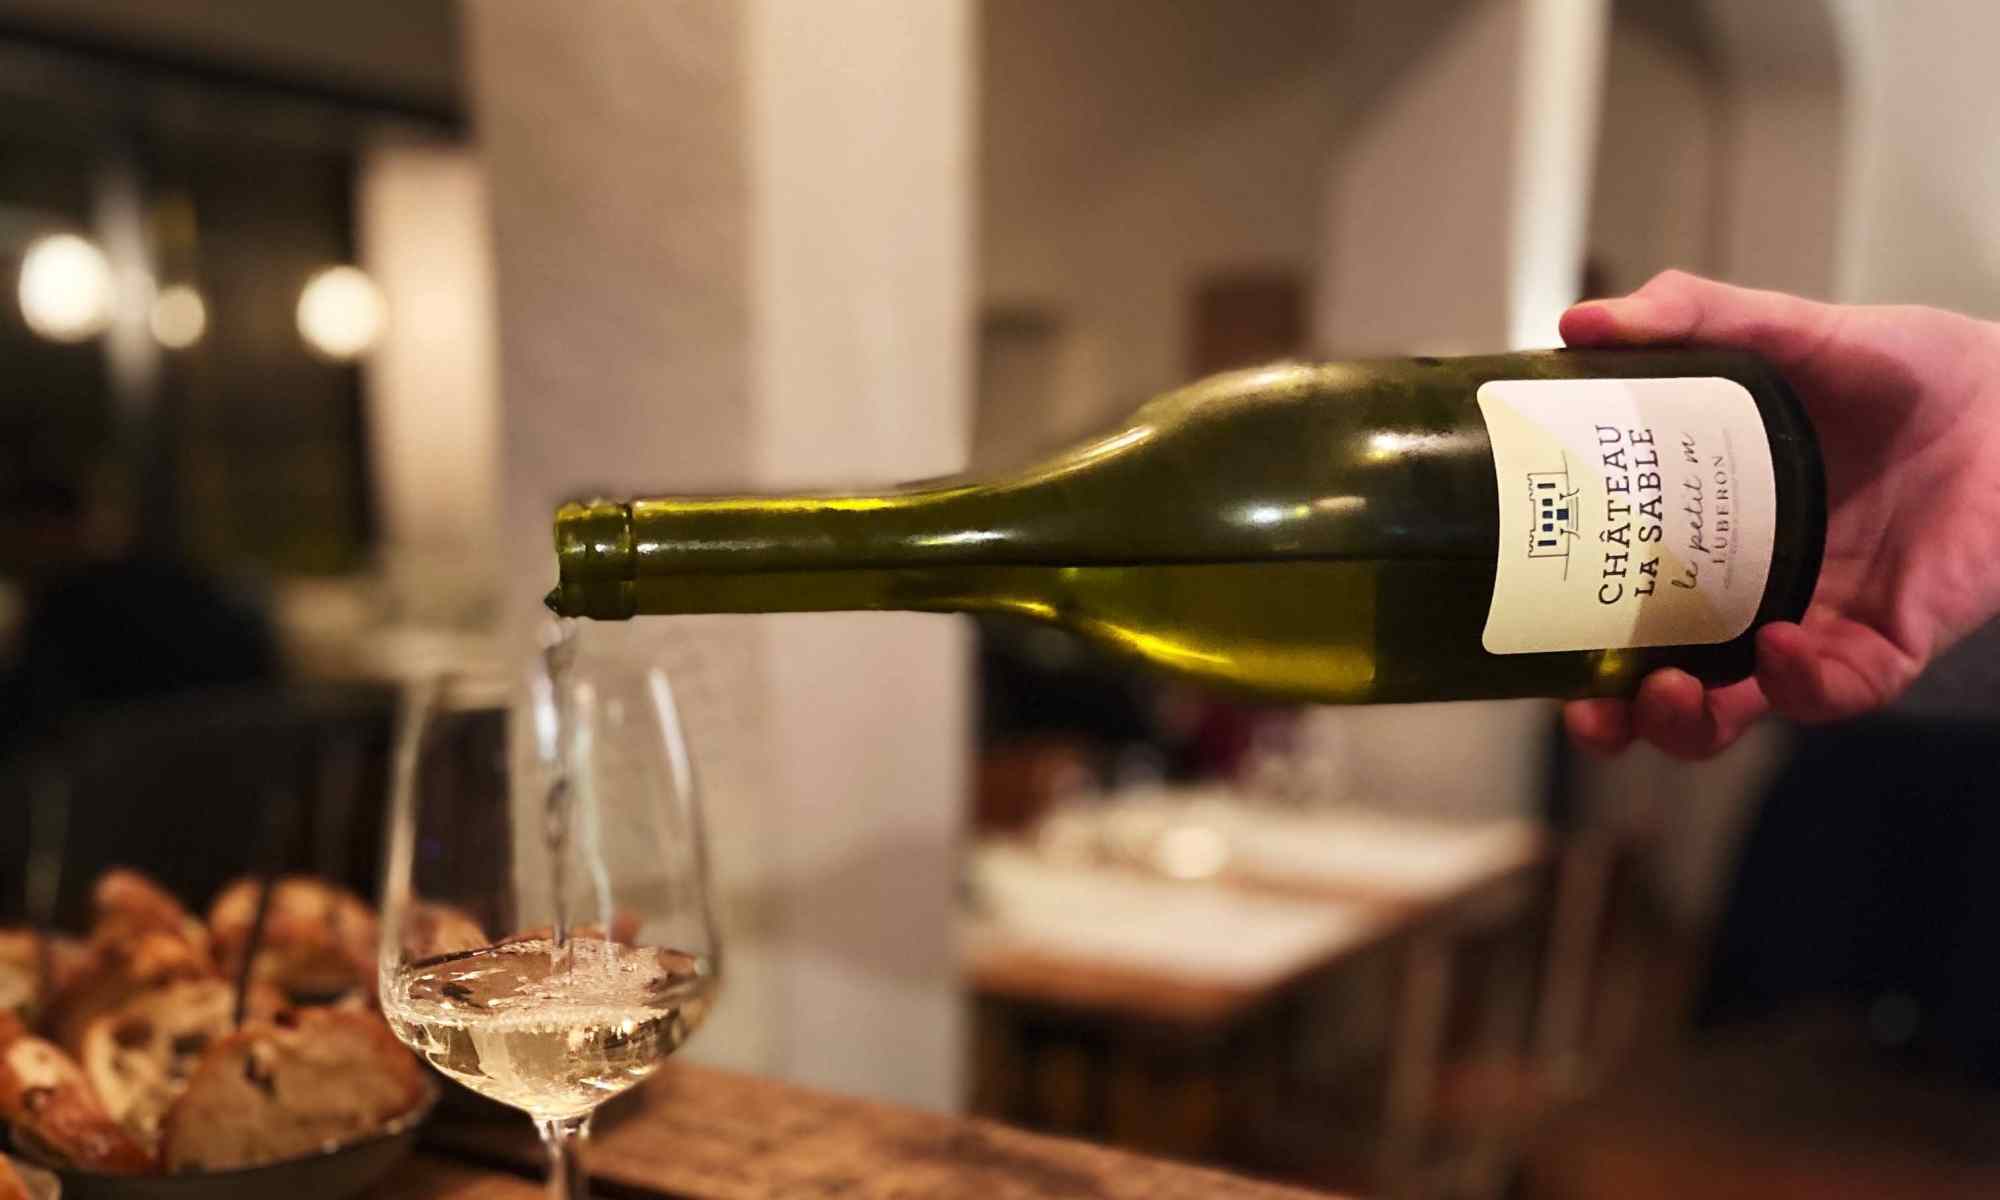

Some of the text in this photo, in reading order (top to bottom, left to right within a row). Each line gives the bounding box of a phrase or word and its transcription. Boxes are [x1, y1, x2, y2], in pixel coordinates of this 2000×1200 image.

[1595, 424, 1631, 605] CHÂTEAU
[1629, 428, 1663, 597] LA SABLE
[1683, 475, 1711, 553] petit
[1672, 560, 1698, 589] le
